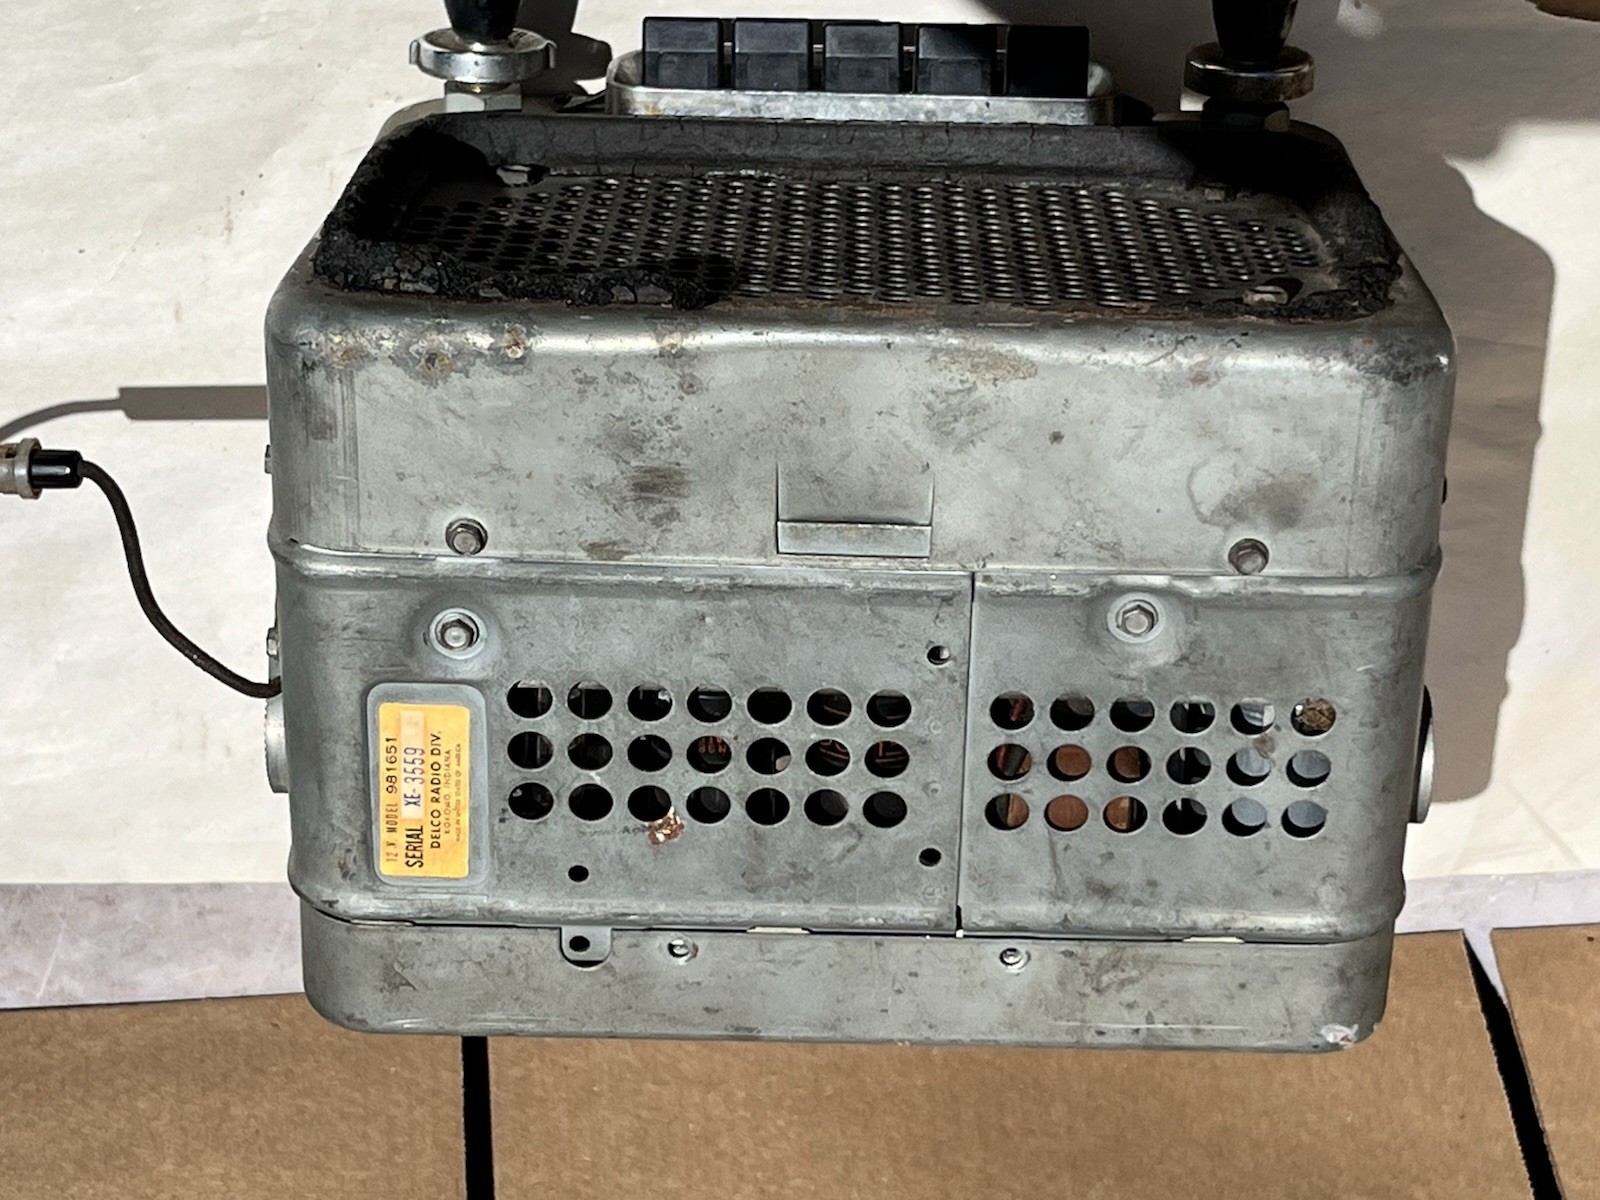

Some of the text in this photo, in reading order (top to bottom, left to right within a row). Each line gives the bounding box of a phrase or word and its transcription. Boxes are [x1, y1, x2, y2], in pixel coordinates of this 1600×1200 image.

[385, 737, 397, 794] 981651
[444, 749, 452, 788] INDIANA
[430, 731, 441, 849] DELCO RADIO DIV.
[385, 803, 398, 833] MODEL
[386, 852, 398, 862] 12
[405, 825, 424, 868] SERIAL
